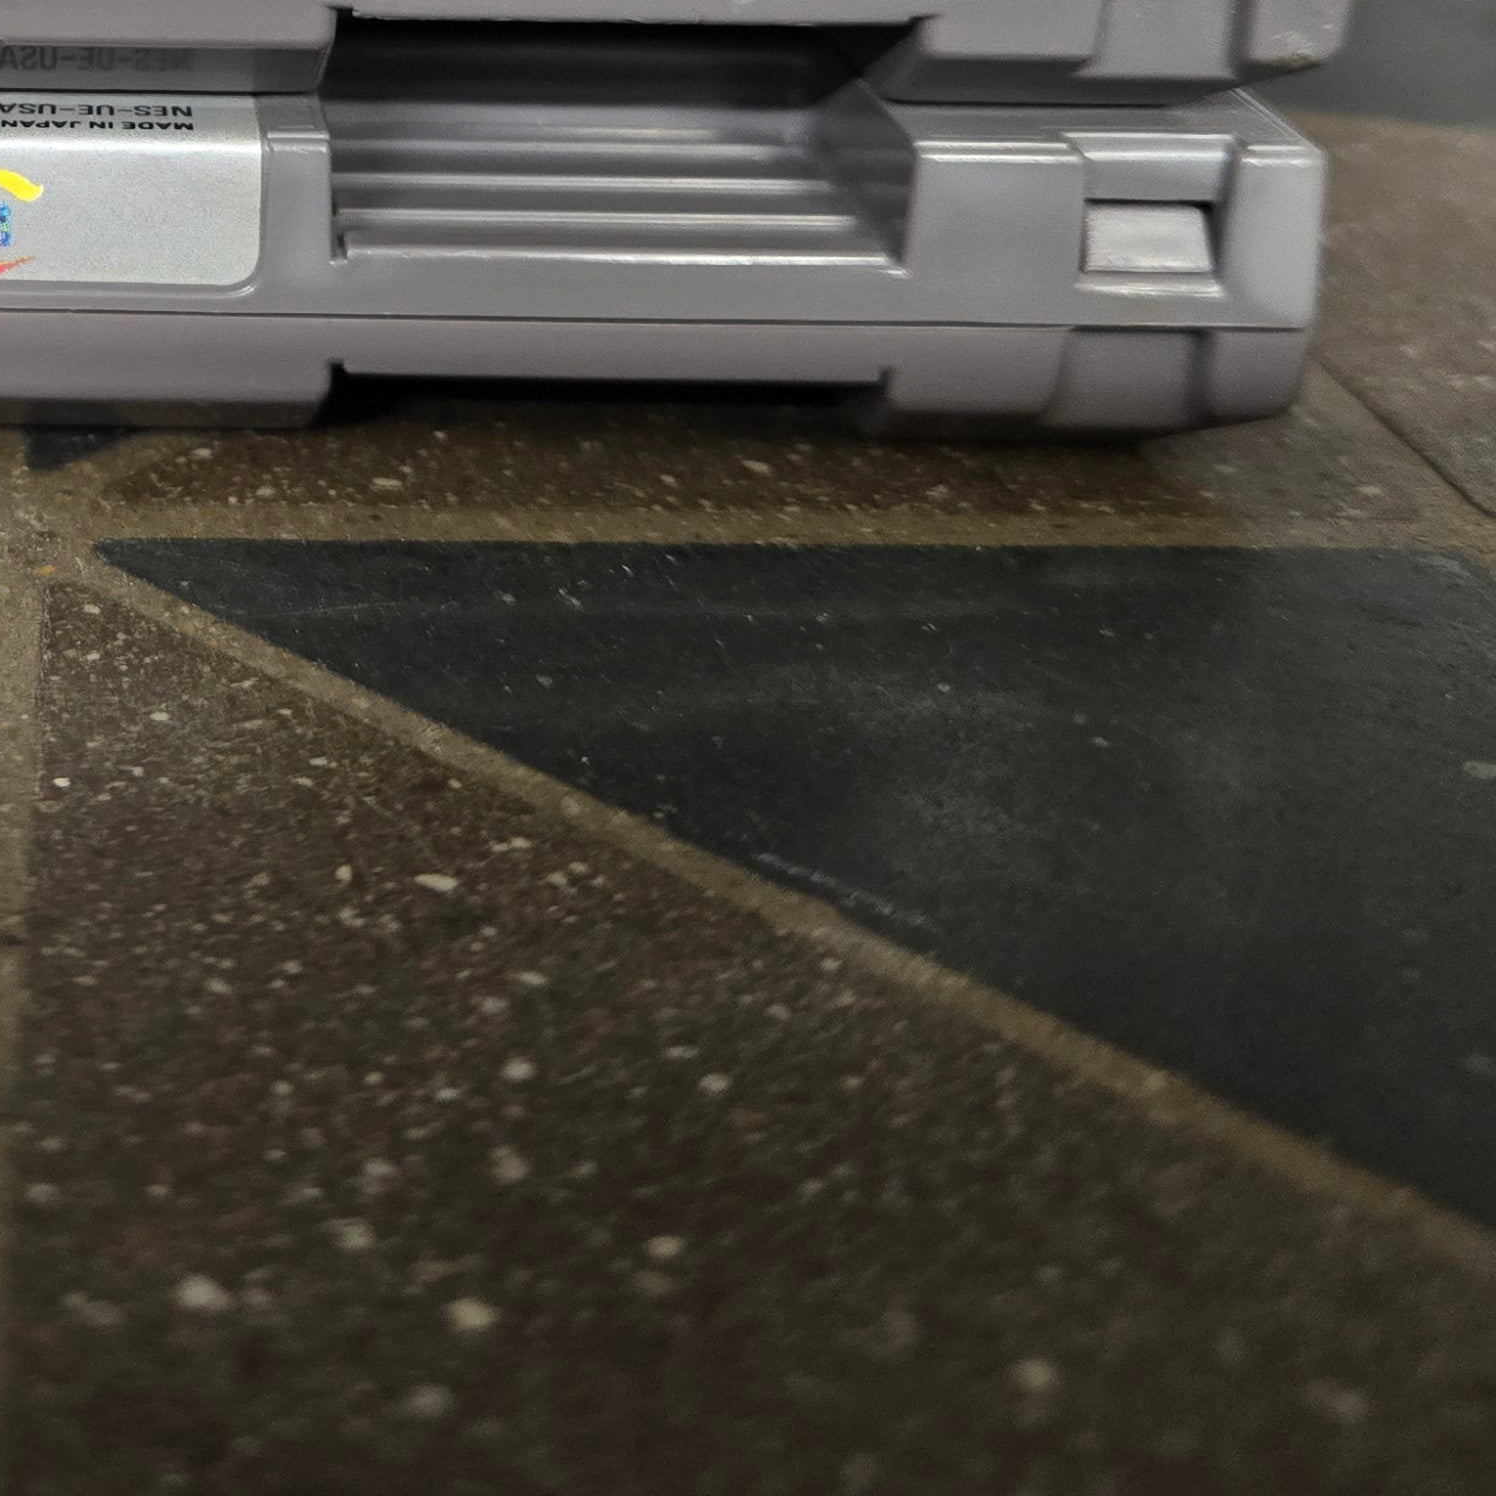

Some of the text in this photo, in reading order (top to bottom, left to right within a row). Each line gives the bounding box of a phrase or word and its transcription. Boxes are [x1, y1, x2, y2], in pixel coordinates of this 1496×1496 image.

[1, 119, 194, 131] MADE IN JAPAN
